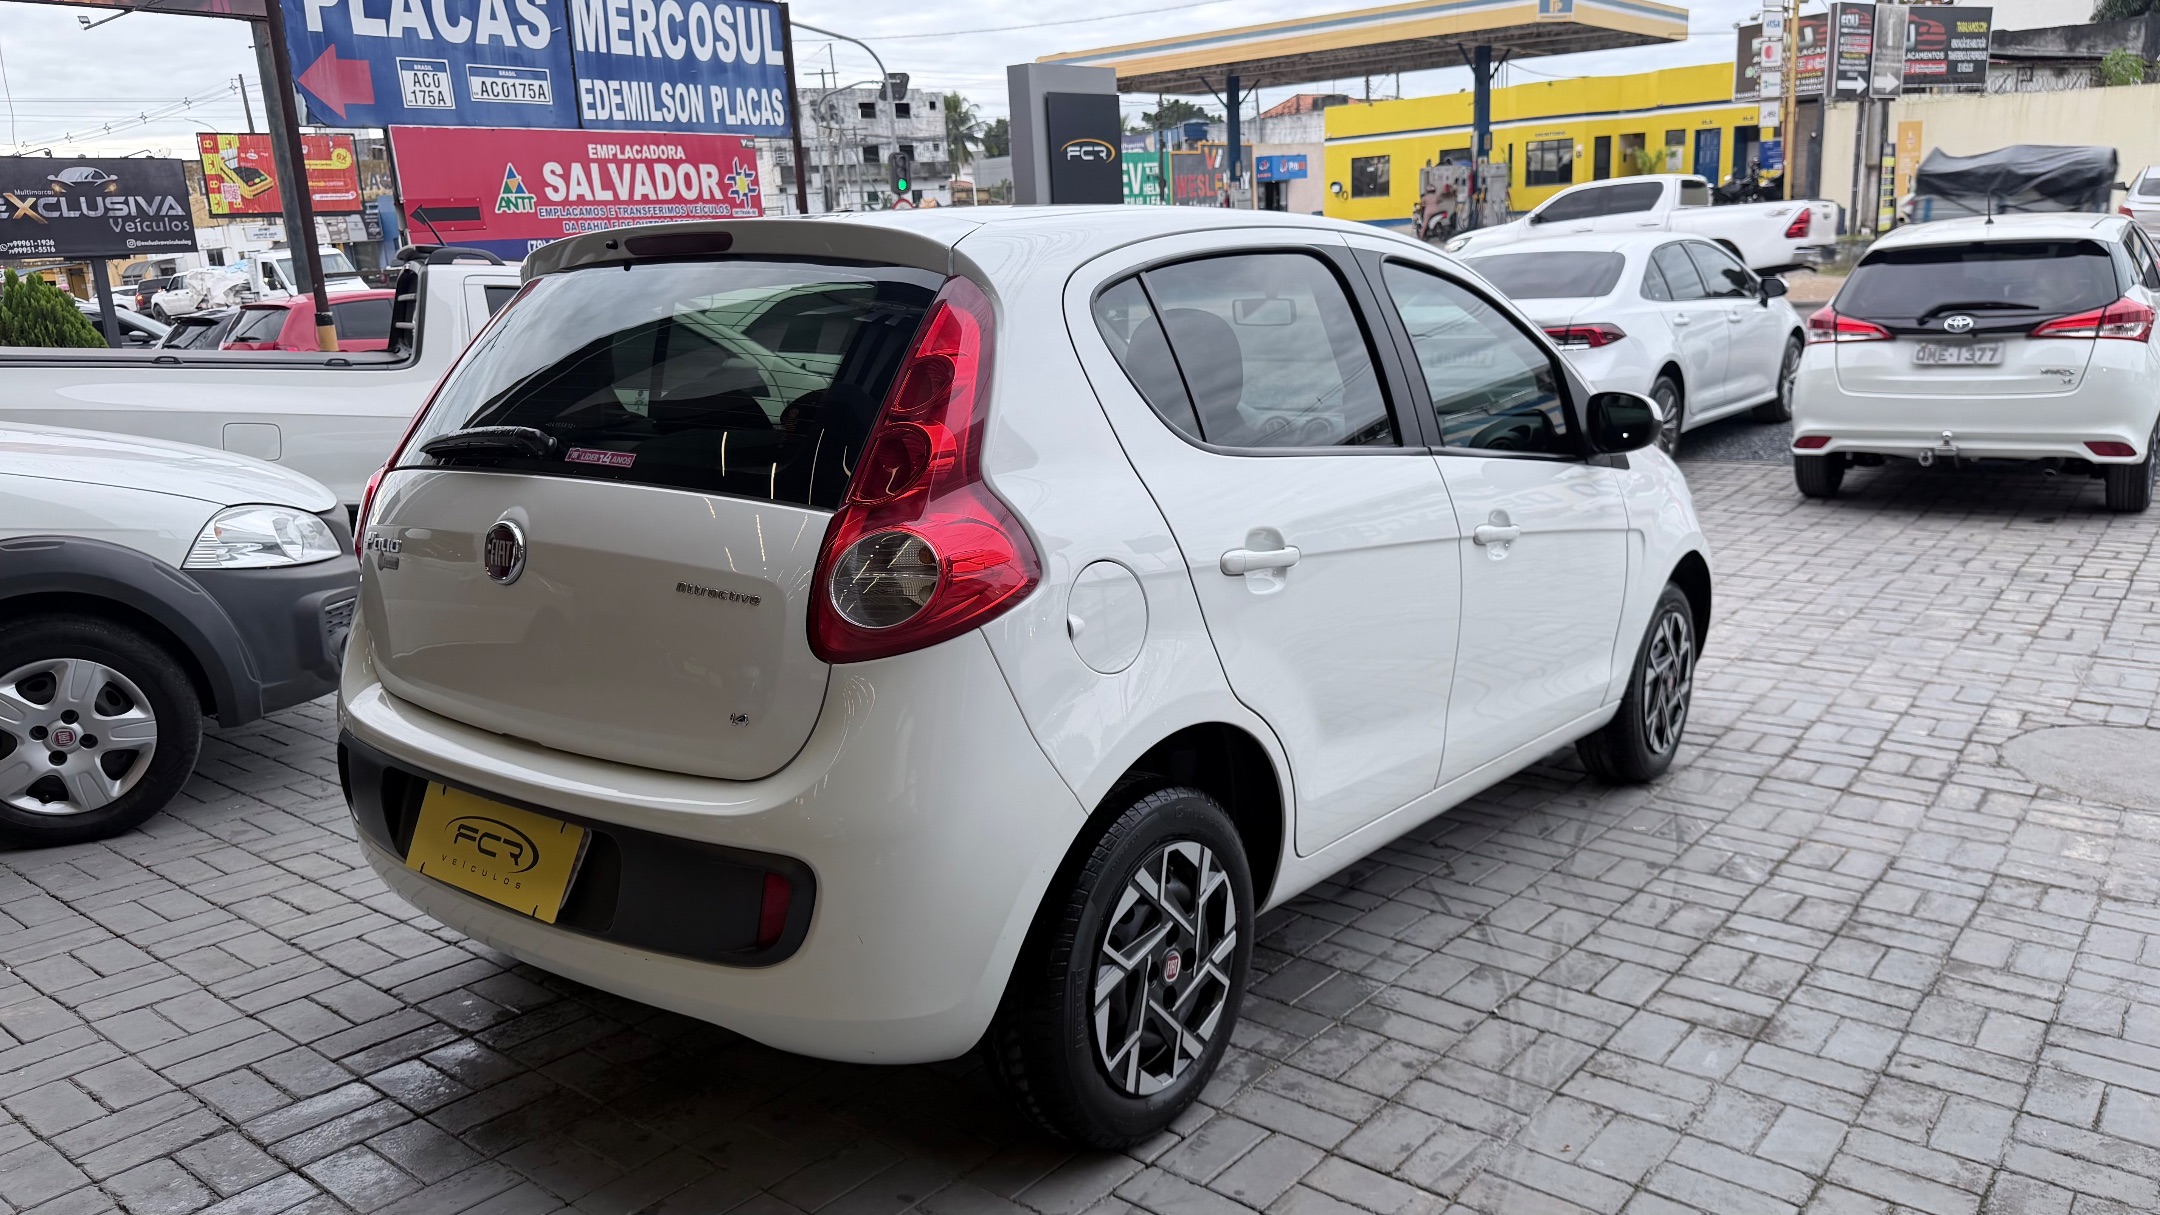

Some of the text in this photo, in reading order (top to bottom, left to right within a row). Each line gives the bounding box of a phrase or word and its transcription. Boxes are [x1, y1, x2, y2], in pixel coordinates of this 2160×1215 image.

[304, 0, 551, 50] PLACAS
[572, 0, 785, 66] MERCOSUL
[411, 89, 447, 105] 175A
[579, 78, 785, 126] EDEMILSON PLACAS
[588, 143, 686, 160] EMPLACADORA
[1067, 145, 1107, 161] FCR
[542, 161, 723, 202] SALVADOR
[495, 194, 537, 214] ANTT
[538, 203, 731, 218] EMPLACAMOS E TRANSFERIMOS VEÍCULOS
[109, 216, 190, 233] Veículos
[564, 220, 578, 233] DA
[580, 219, 609, 232] BAHIA
[612, 219, 619, 229] E
[611, 456, 632, 465] ANOS
[490, 537, 513, 567] FIAT
[454, 823, 524, 867] FCR
